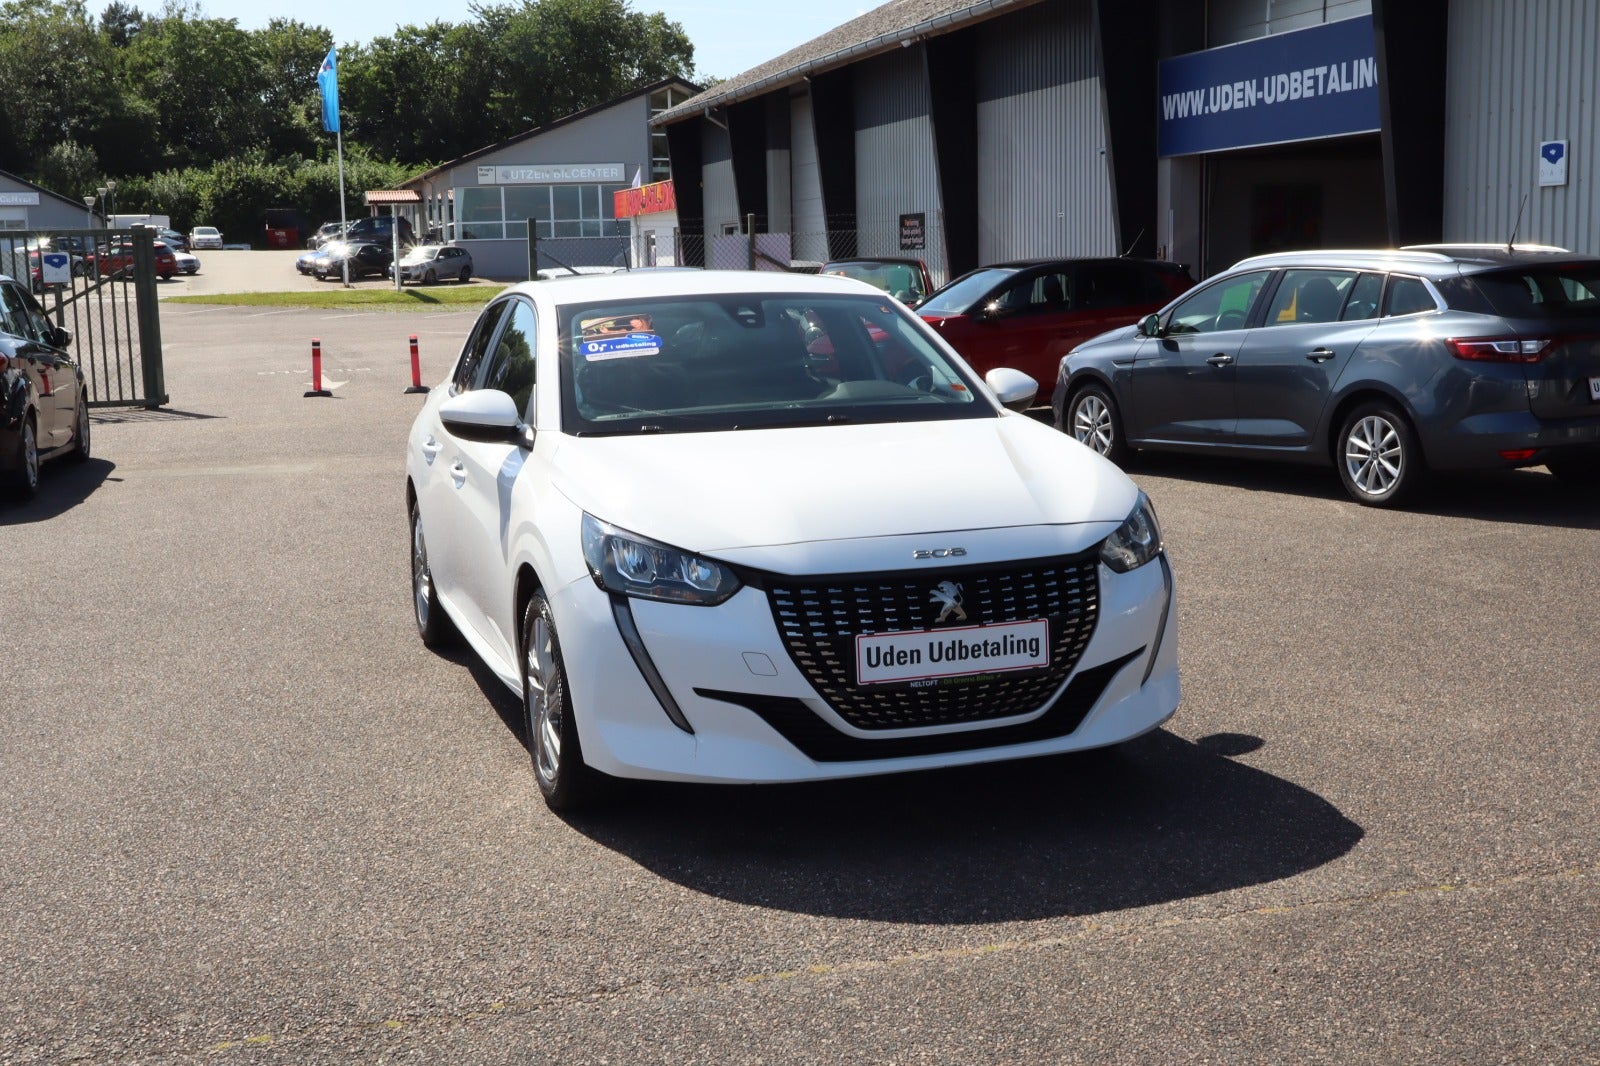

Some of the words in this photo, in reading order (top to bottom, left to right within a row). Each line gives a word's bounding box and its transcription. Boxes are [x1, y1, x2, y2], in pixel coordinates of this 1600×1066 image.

[913, 547, 967, 559] 208
[866, 645, 922, 669] Uden
[929, 634, 1039, 662] Udbetaling
[910, 679, 939, 688] NELTOFT
